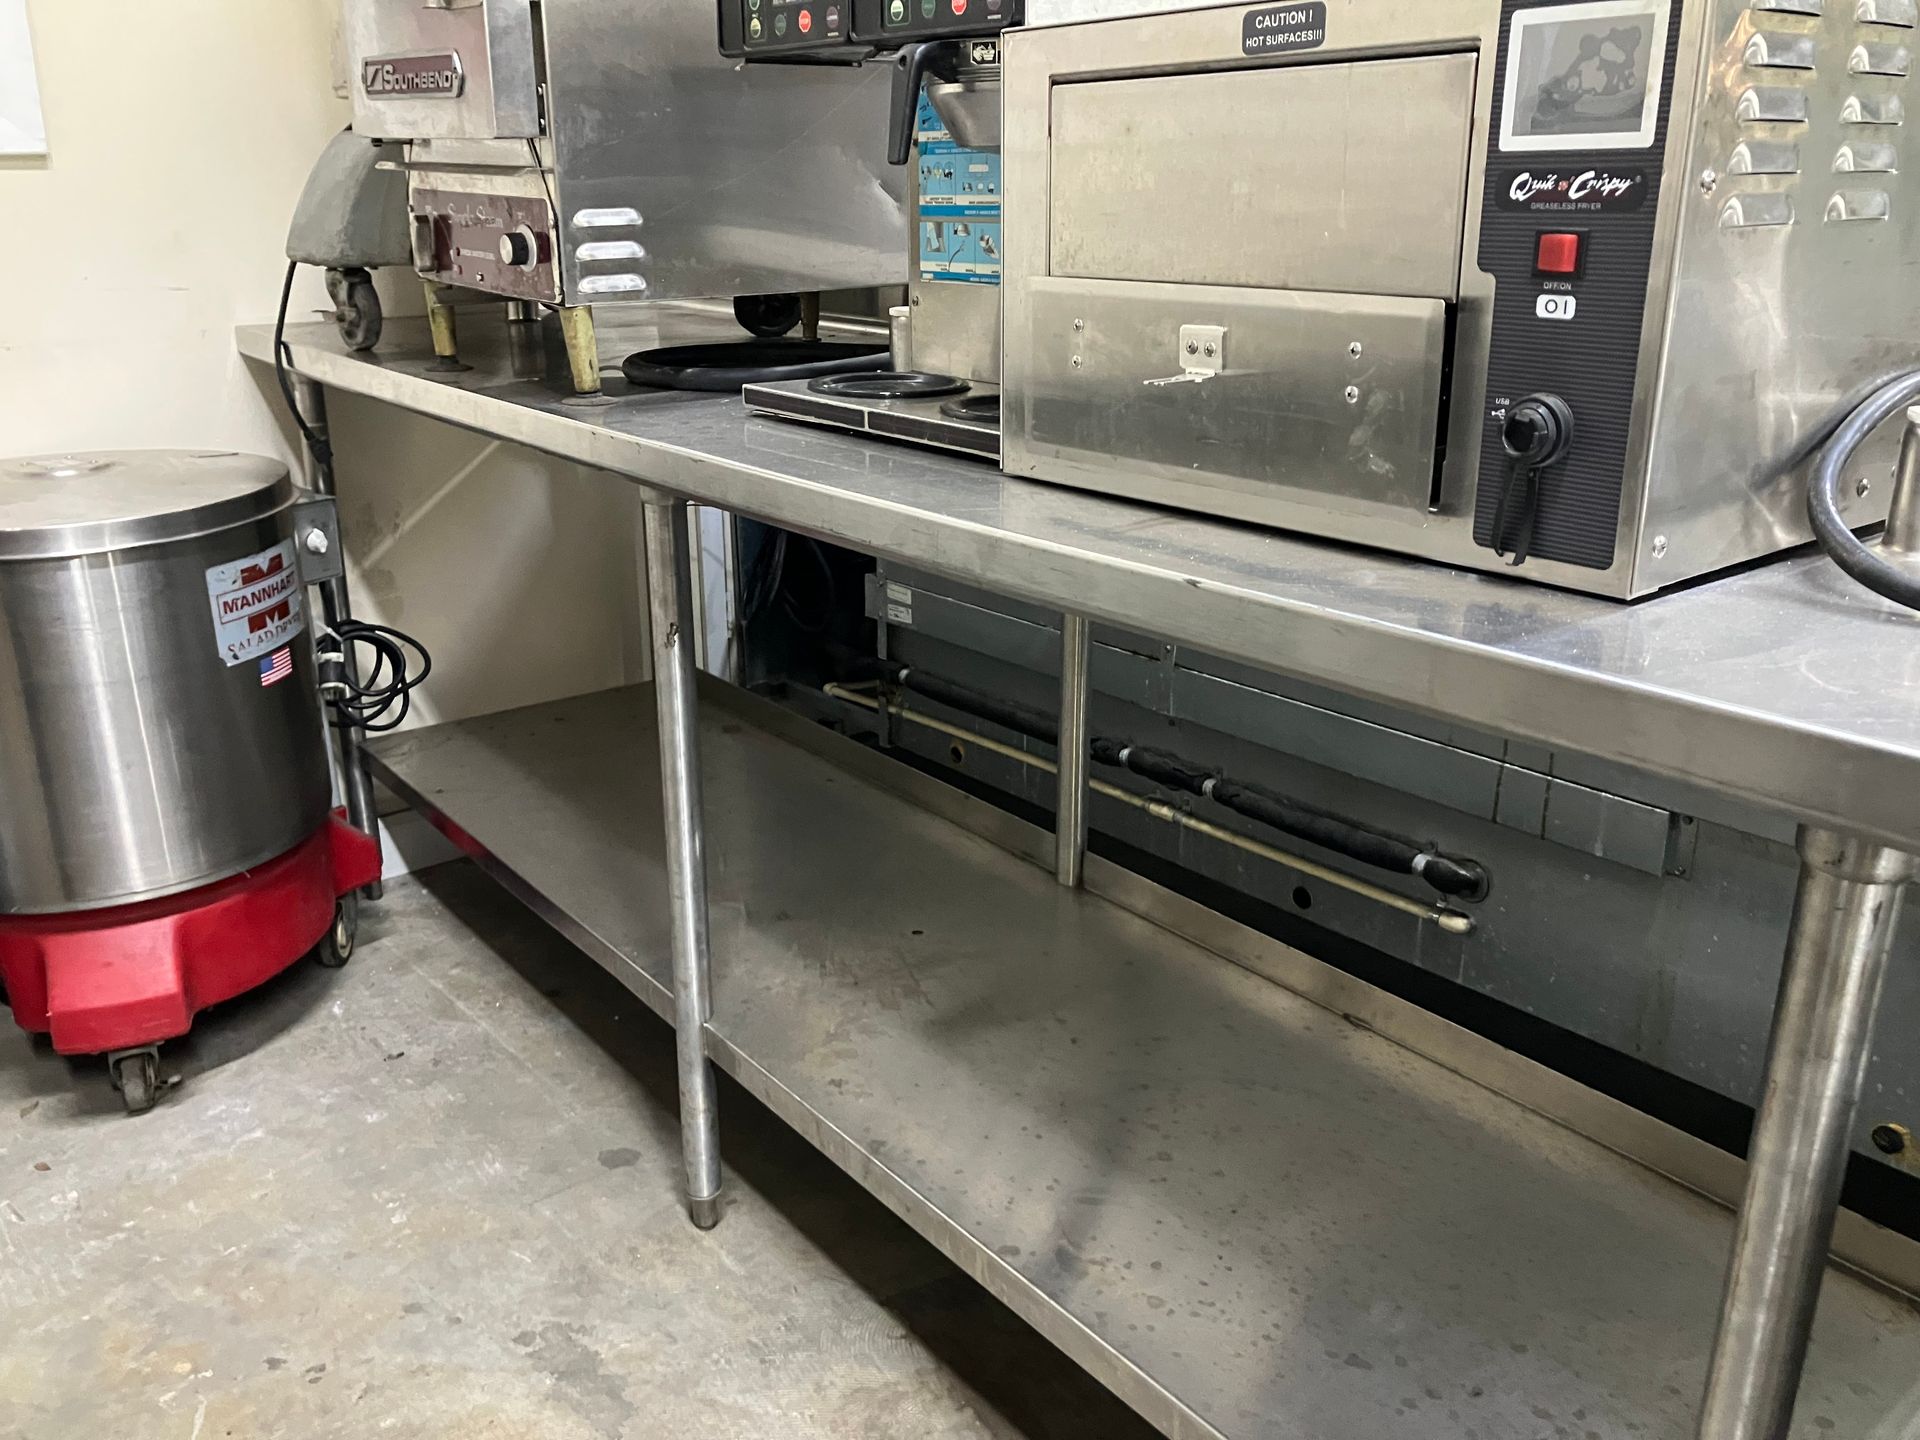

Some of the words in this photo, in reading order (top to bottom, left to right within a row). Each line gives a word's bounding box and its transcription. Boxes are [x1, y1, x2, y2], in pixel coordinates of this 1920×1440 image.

[1255, 10, 1306, 29] CAUTION
[1246, 36, 1264, 48] HOT
[1509, 172, 1558, 201] Quik
[1530, 202, 1576, 210] GREASELESS
[1495, 397, 1510, 406] USB
